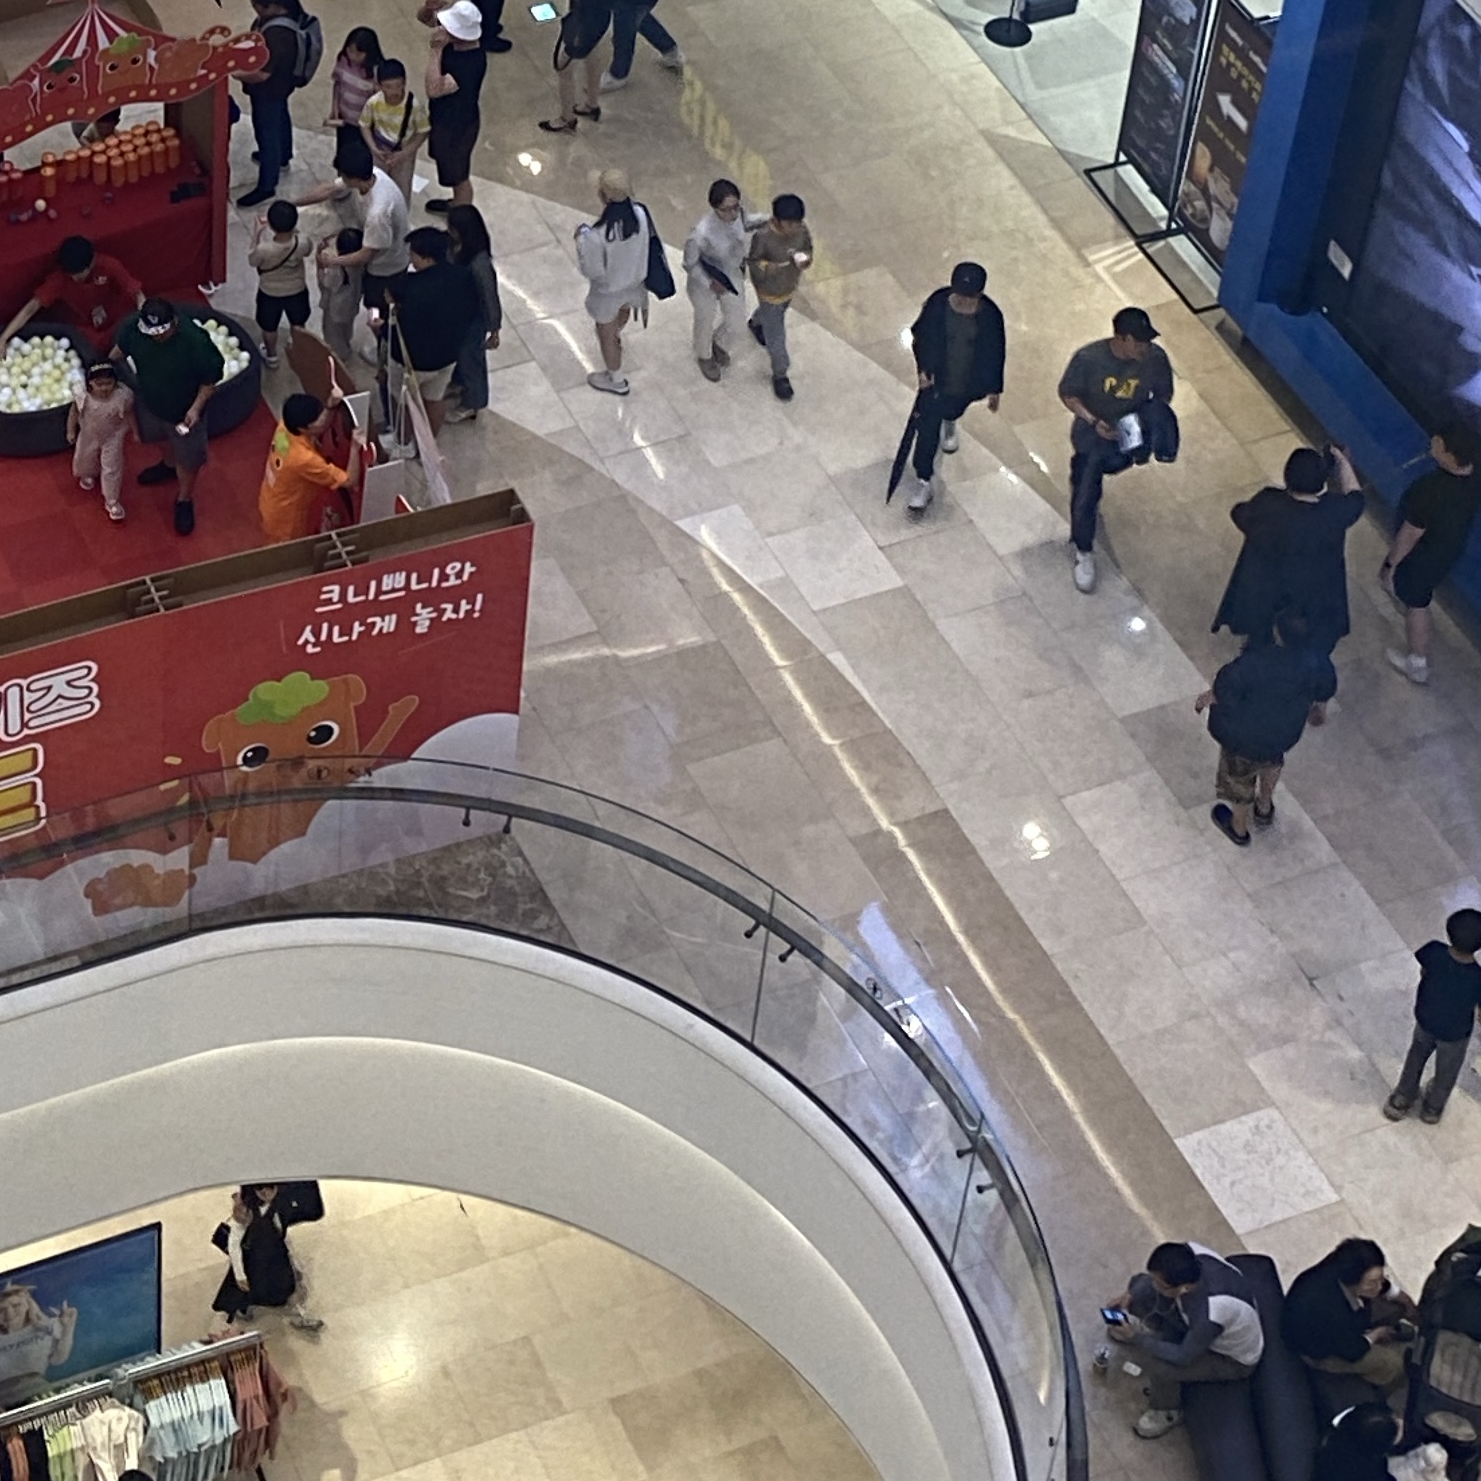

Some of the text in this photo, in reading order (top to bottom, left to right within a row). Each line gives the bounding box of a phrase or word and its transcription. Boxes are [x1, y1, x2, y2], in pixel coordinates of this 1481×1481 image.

[314, 561, 477, 613] 크니쁘니와
[296, 593, 484, 654] 신나게 놀자!
